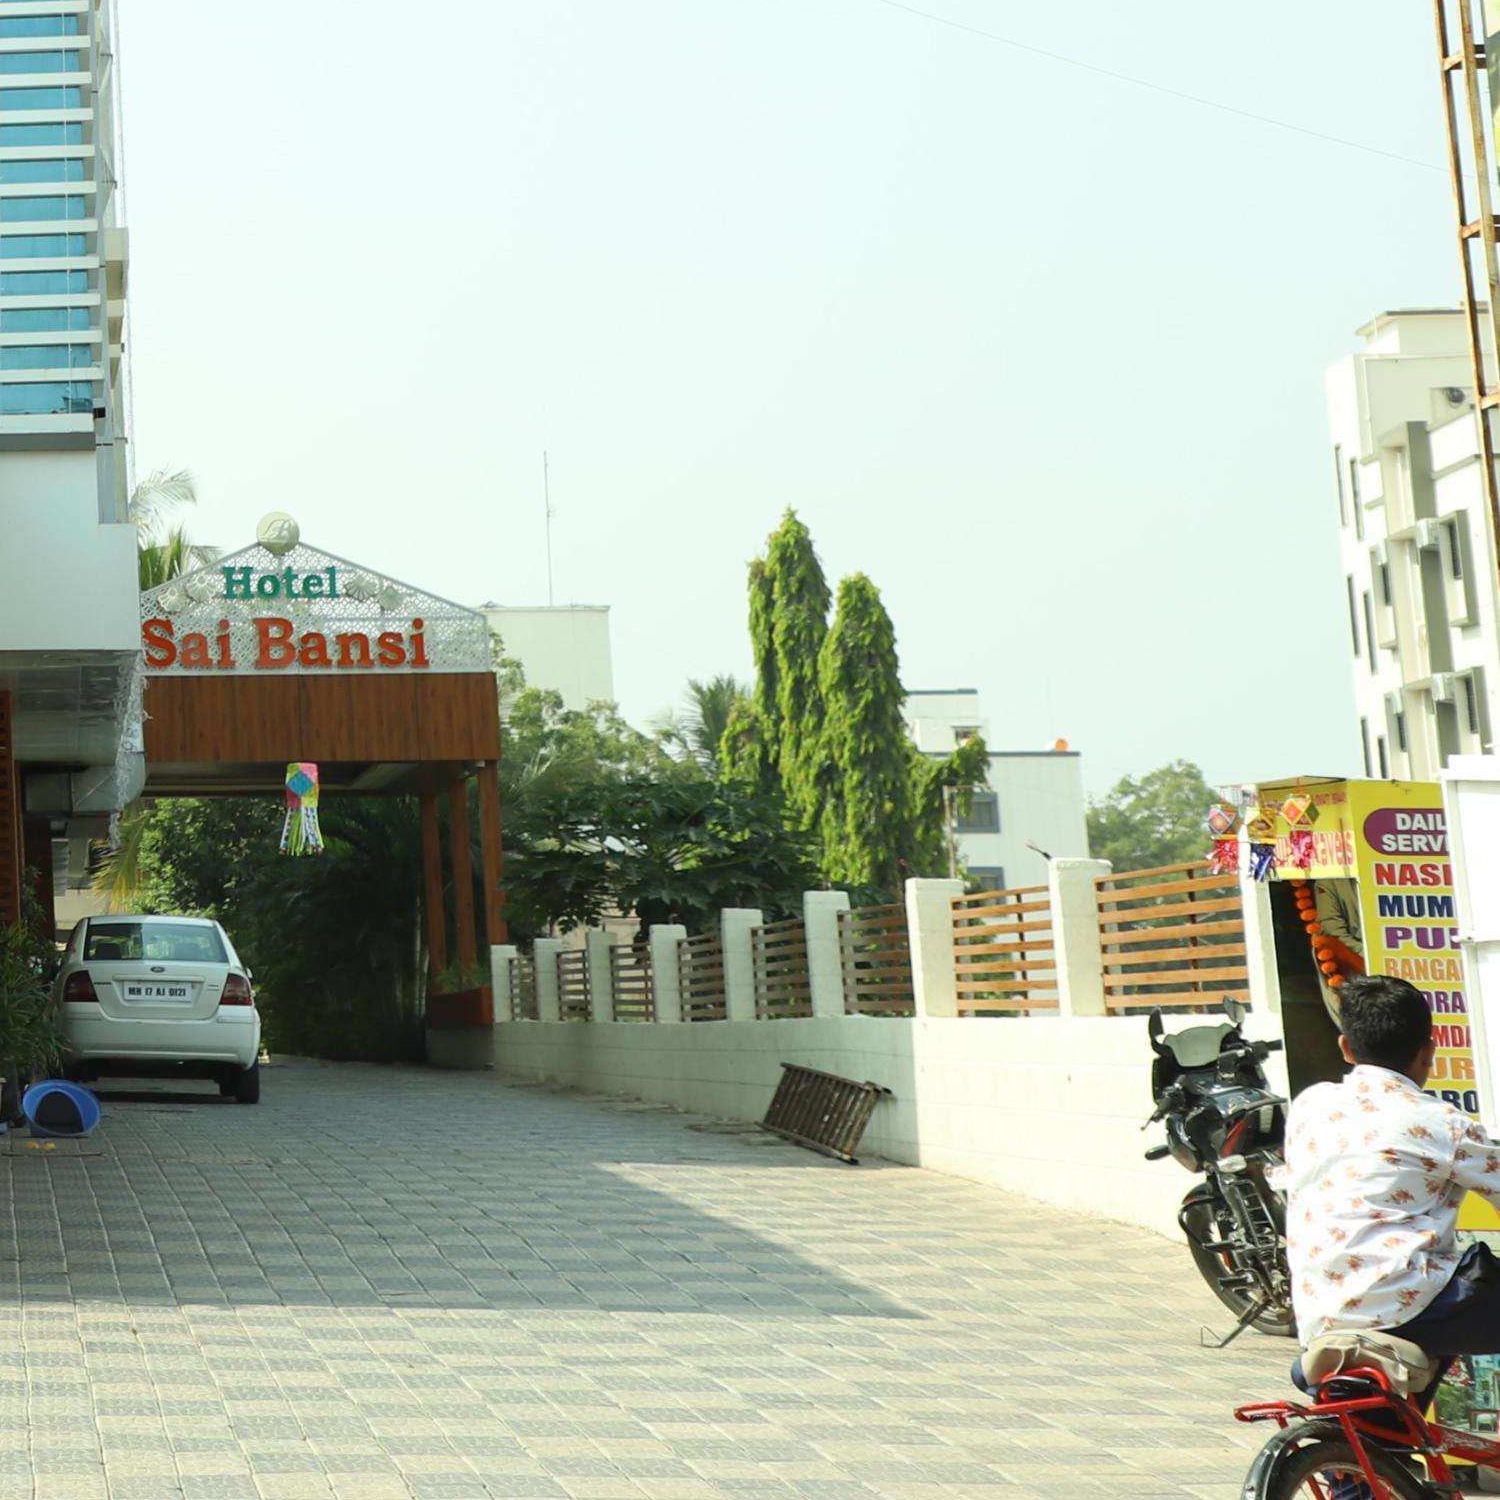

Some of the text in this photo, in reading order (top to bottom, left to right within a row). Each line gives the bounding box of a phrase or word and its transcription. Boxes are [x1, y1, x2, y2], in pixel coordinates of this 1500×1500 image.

[222, 566, 340, 599] Hotel
[142, 617, 430, 668] Sai Bansi
[128, 987, 142, 996] MH
